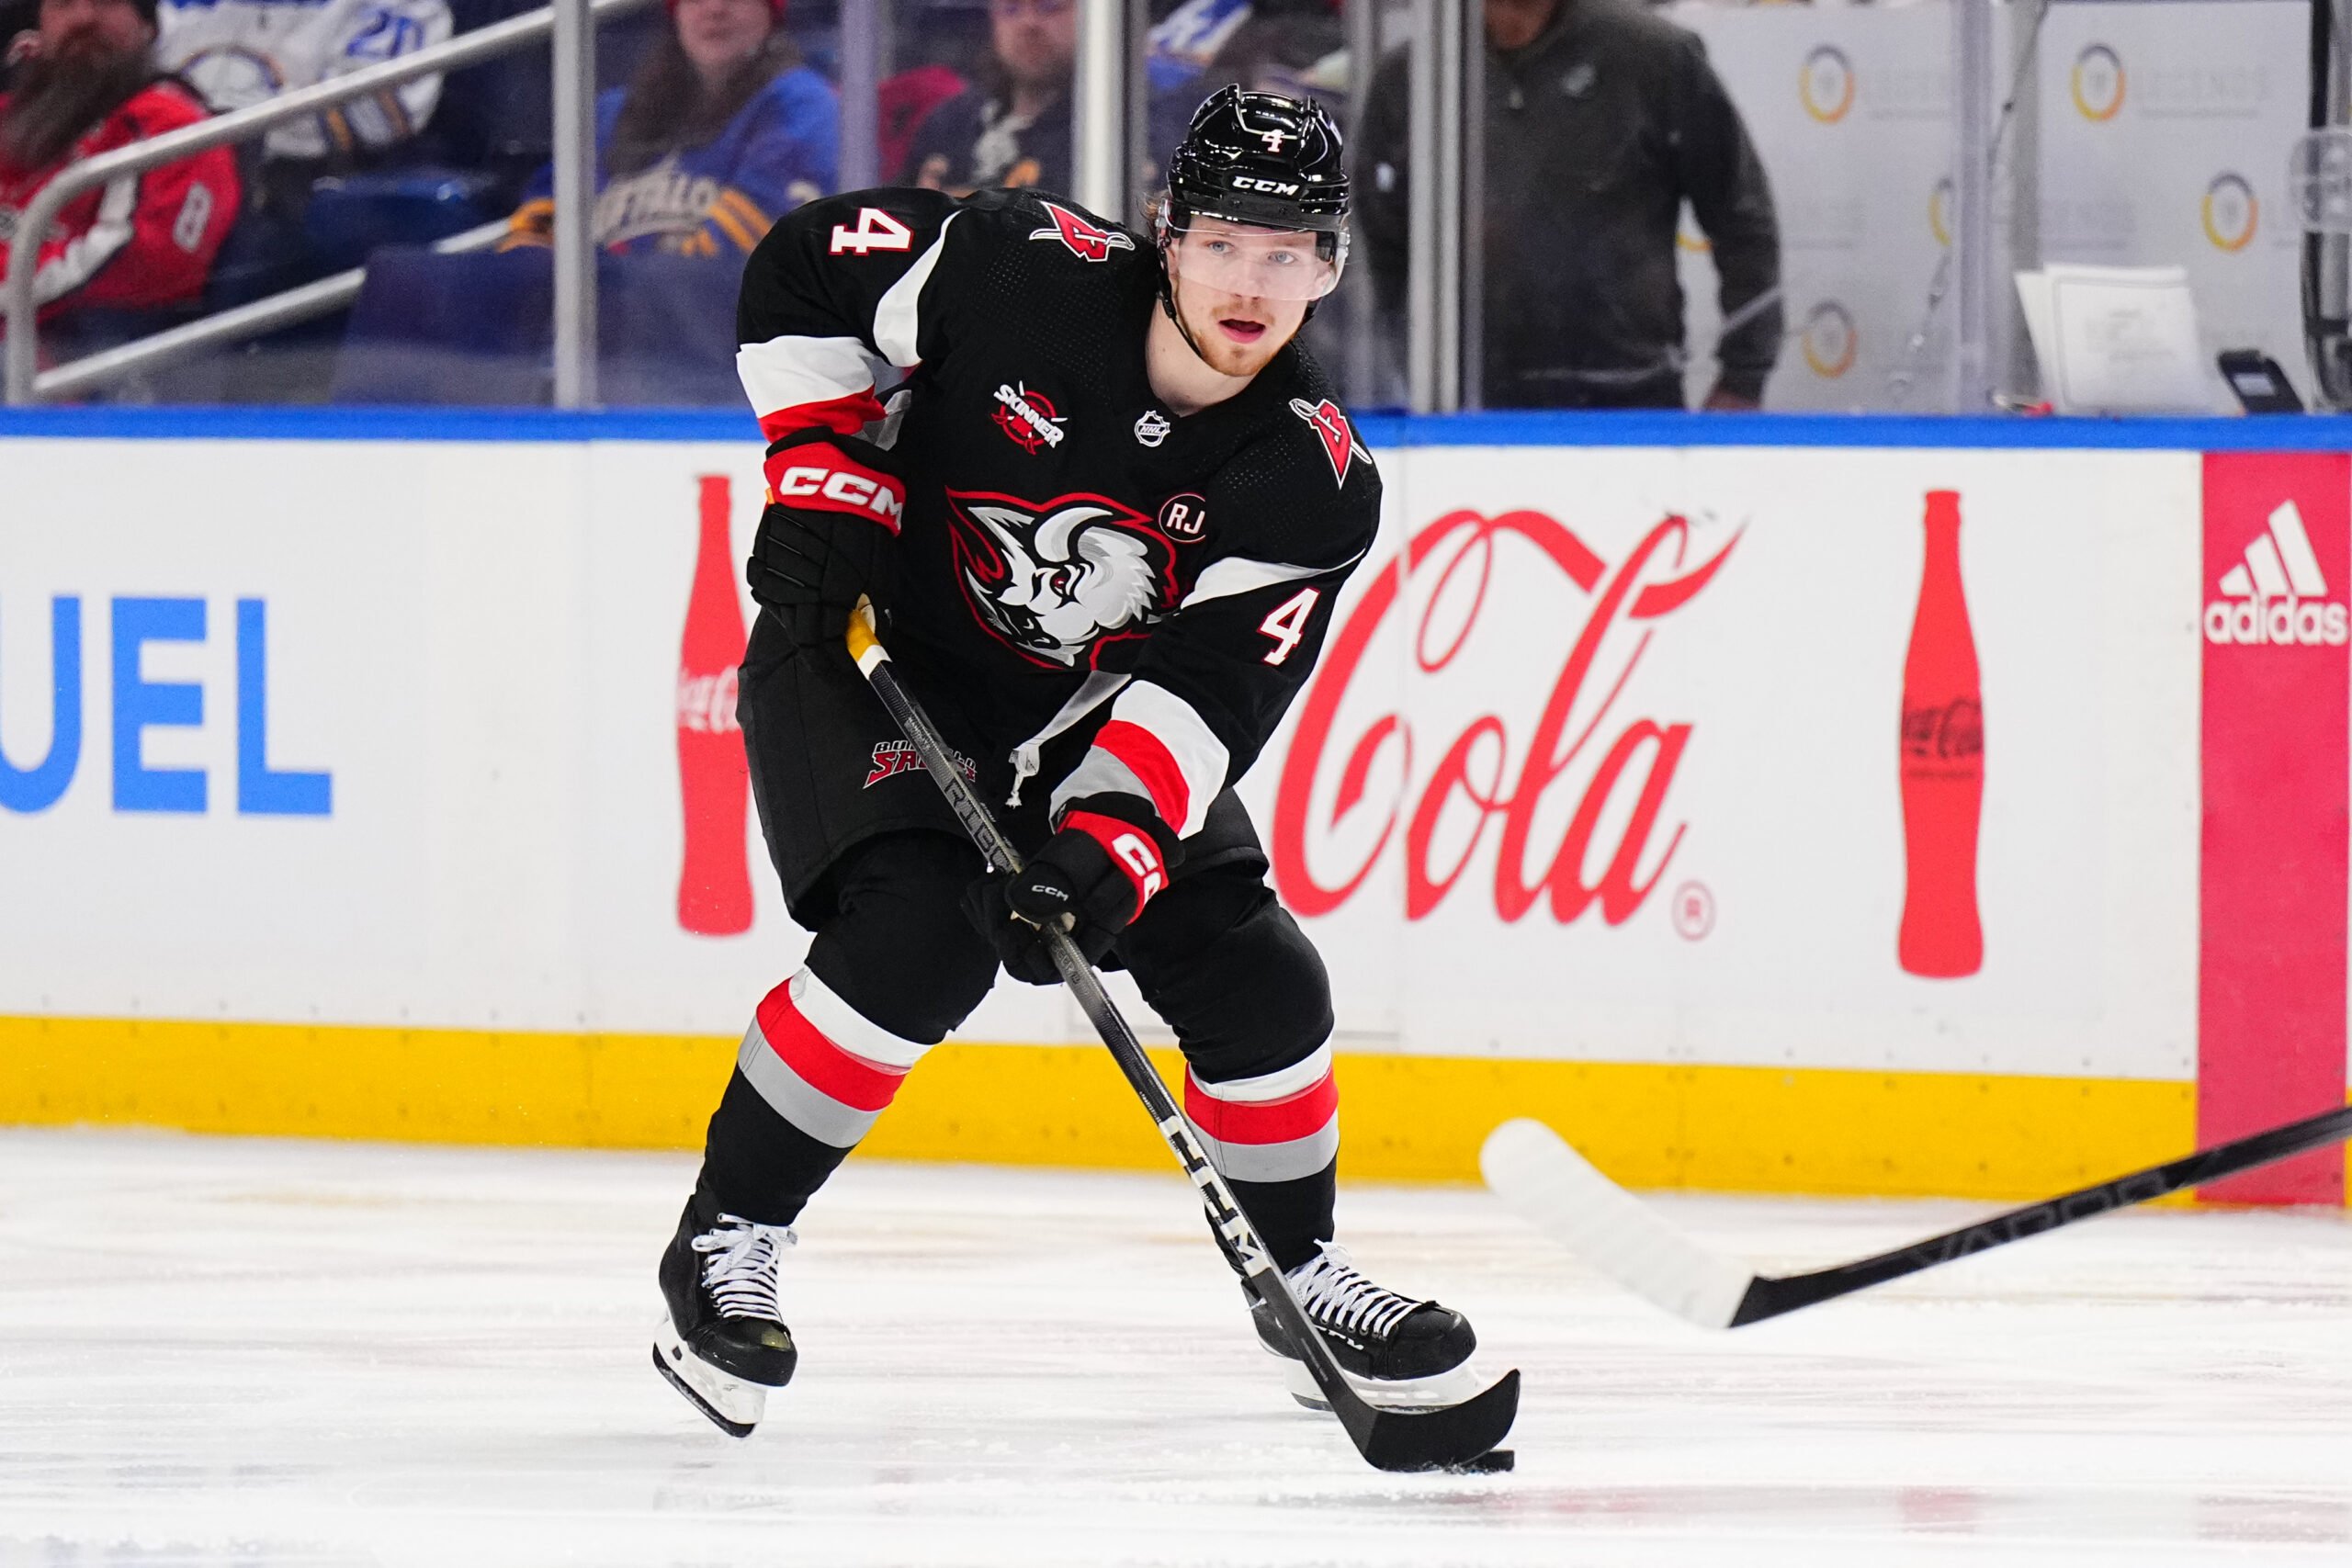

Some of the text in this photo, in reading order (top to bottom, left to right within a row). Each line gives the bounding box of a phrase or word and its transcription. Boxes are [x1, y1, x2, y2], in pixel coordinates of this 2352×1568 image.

[1261, 128, 1285, 153] 4
[1232, 175, 1300, 197] CCM
[829, 207, 913, 256] 4
[993, 384, 1064, 448] SKINNER
[1139, 424, 1164, 434] NHL
[779, 466, 904, 532] CCM
[1166, 502, 1206, 536] RJ
[1256, 585, 1321, 667] 4
[2205, 592, 2349, 646] adidas
[0, 594, 333, 816] UEL
[1272, 509, 1751, 927] Cola
[1031, 884, 1069, 902] CCM
[1112, 832, 1162, 905] CC
[1159, 1114, 1274, 1278] CCM
